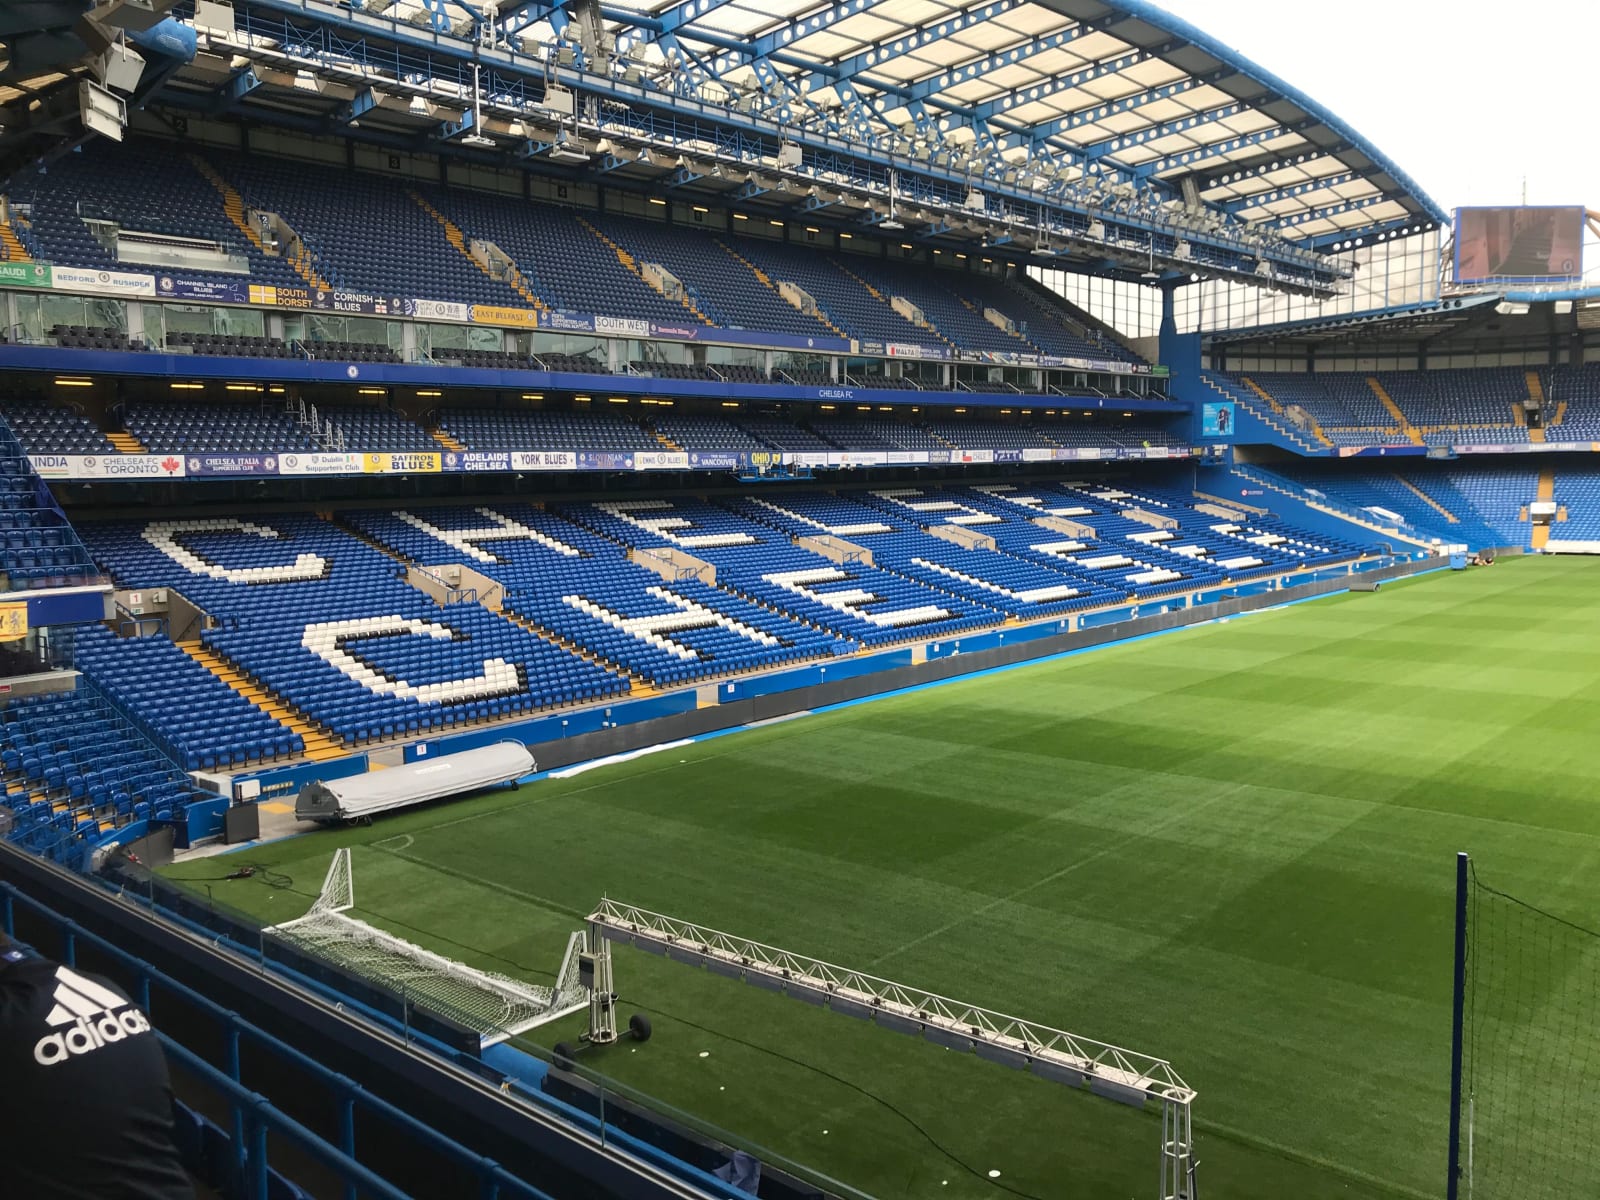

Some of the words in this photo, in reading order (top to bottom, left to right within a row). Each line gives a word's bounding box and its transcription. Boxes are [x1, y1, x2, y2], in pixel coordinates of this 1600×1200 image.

[57, 274, 96, 283] BEDFORD
[113, 279, 150, 288] RUSHDEN
[176, 279, 206, 288] CHANNEL
[276, 287, 308, 298] SOUTH
[277, 297, 313, 308] DORSET
[333, 292, 374, 304] CORNISH
[334, 301, 361, 312] BLUES
[495, 312, 523, 321] BELFAST
[596, 317, 625, 328] SOUTH
[628, 320, 648, 330] WEST
[895, 348, 915, 356] MALTA
[819, 389, 845, 399] CHELSEA
[845, 391, 854, 399] FC
[34, 456, 68, 467] INDIA
[103, 457, 145, 466] CHELSEA
[147, 457, 158, 465] FC
[237, 457, 260, 465] ITALIA
[462, 452, 509, 462] ADELAIDE
[520, 453, 541, 465] YORK
[544, 453, 568, 465] BLUES
[701, 458, 737, 466] VANCOUVER
[751, 452, 770, 464] OHIO
[103, 465, 159, 474] TORONTO
[305, 464, 343, 472] Supporters
[391, 461, 435, 470] BLUES
[464, 461, 509, 471] CHELSEA
[302, 523, 1331, 705] CHELSEA
[34, 1008, 151, 1066] adidas
